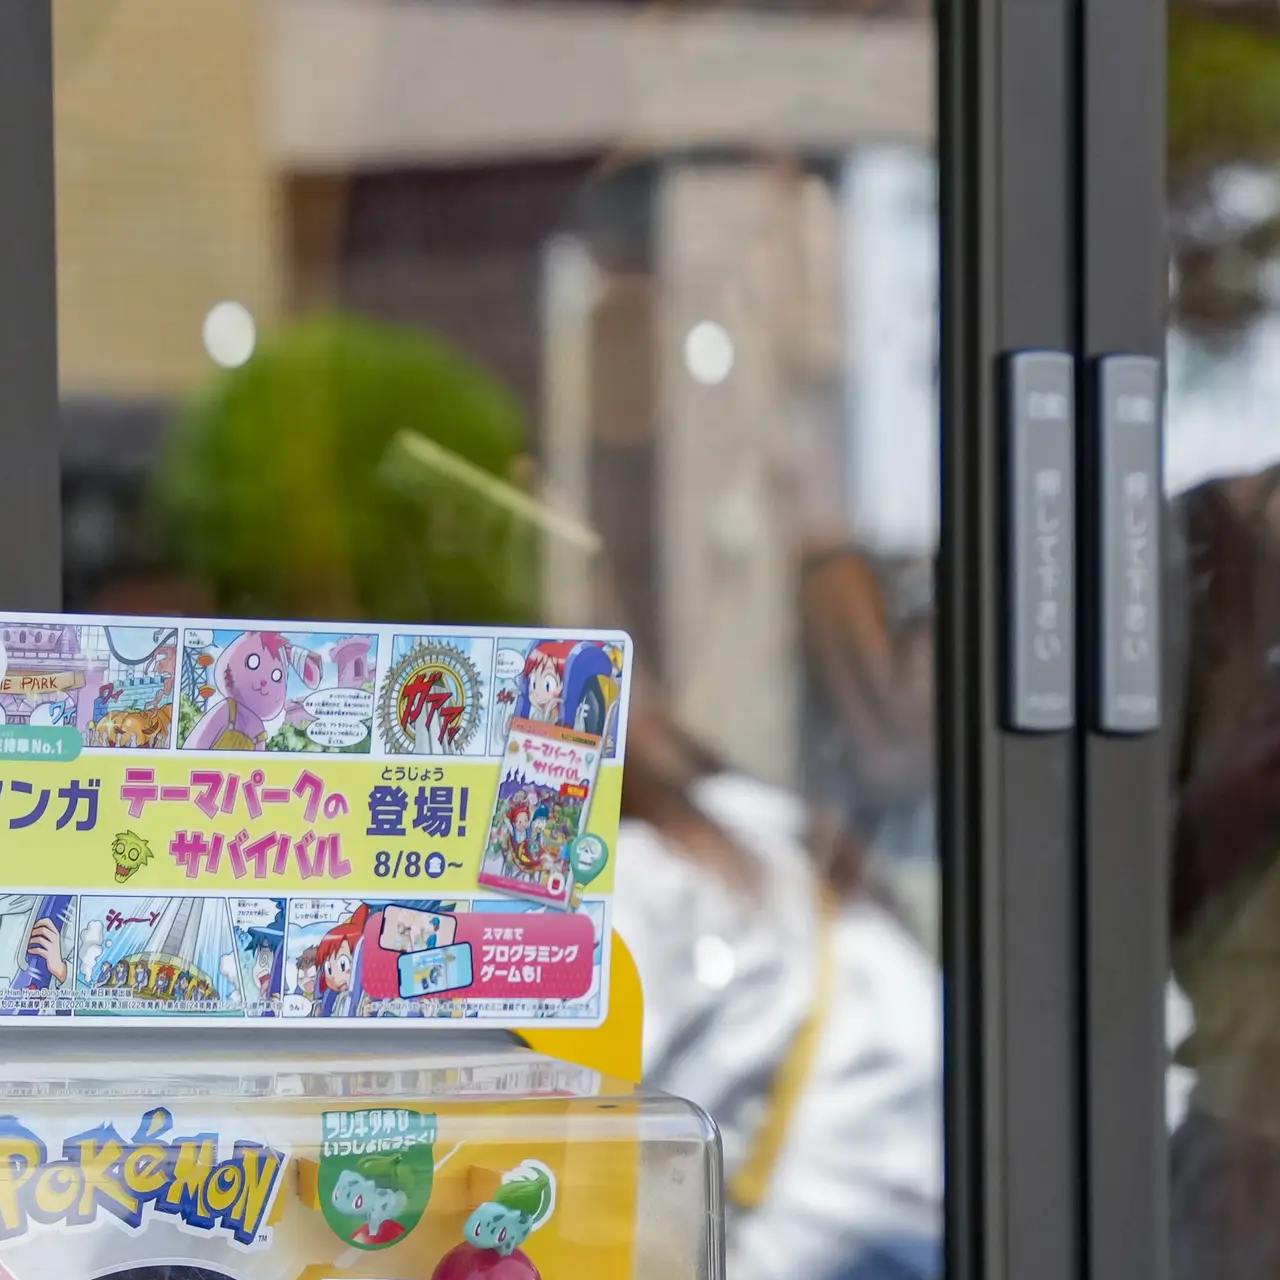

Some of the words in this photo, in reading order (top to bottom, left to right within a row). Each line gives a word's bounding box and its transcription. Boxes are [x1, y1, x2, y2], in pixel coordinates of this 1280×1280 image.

[22, 677, 58, 690] PARK
[381, 766, 444, 782] とうじょう
[120, 768, 349, 823] テーマパークの
[366, 785, 469, 838] 登場!
[169, 828, 352, 880] サバイバル
[483, 928, 524, 941] スマホで
[482, 945, 579, 963] プログラミング
[480, 965, 541, 983] ゲームも!
